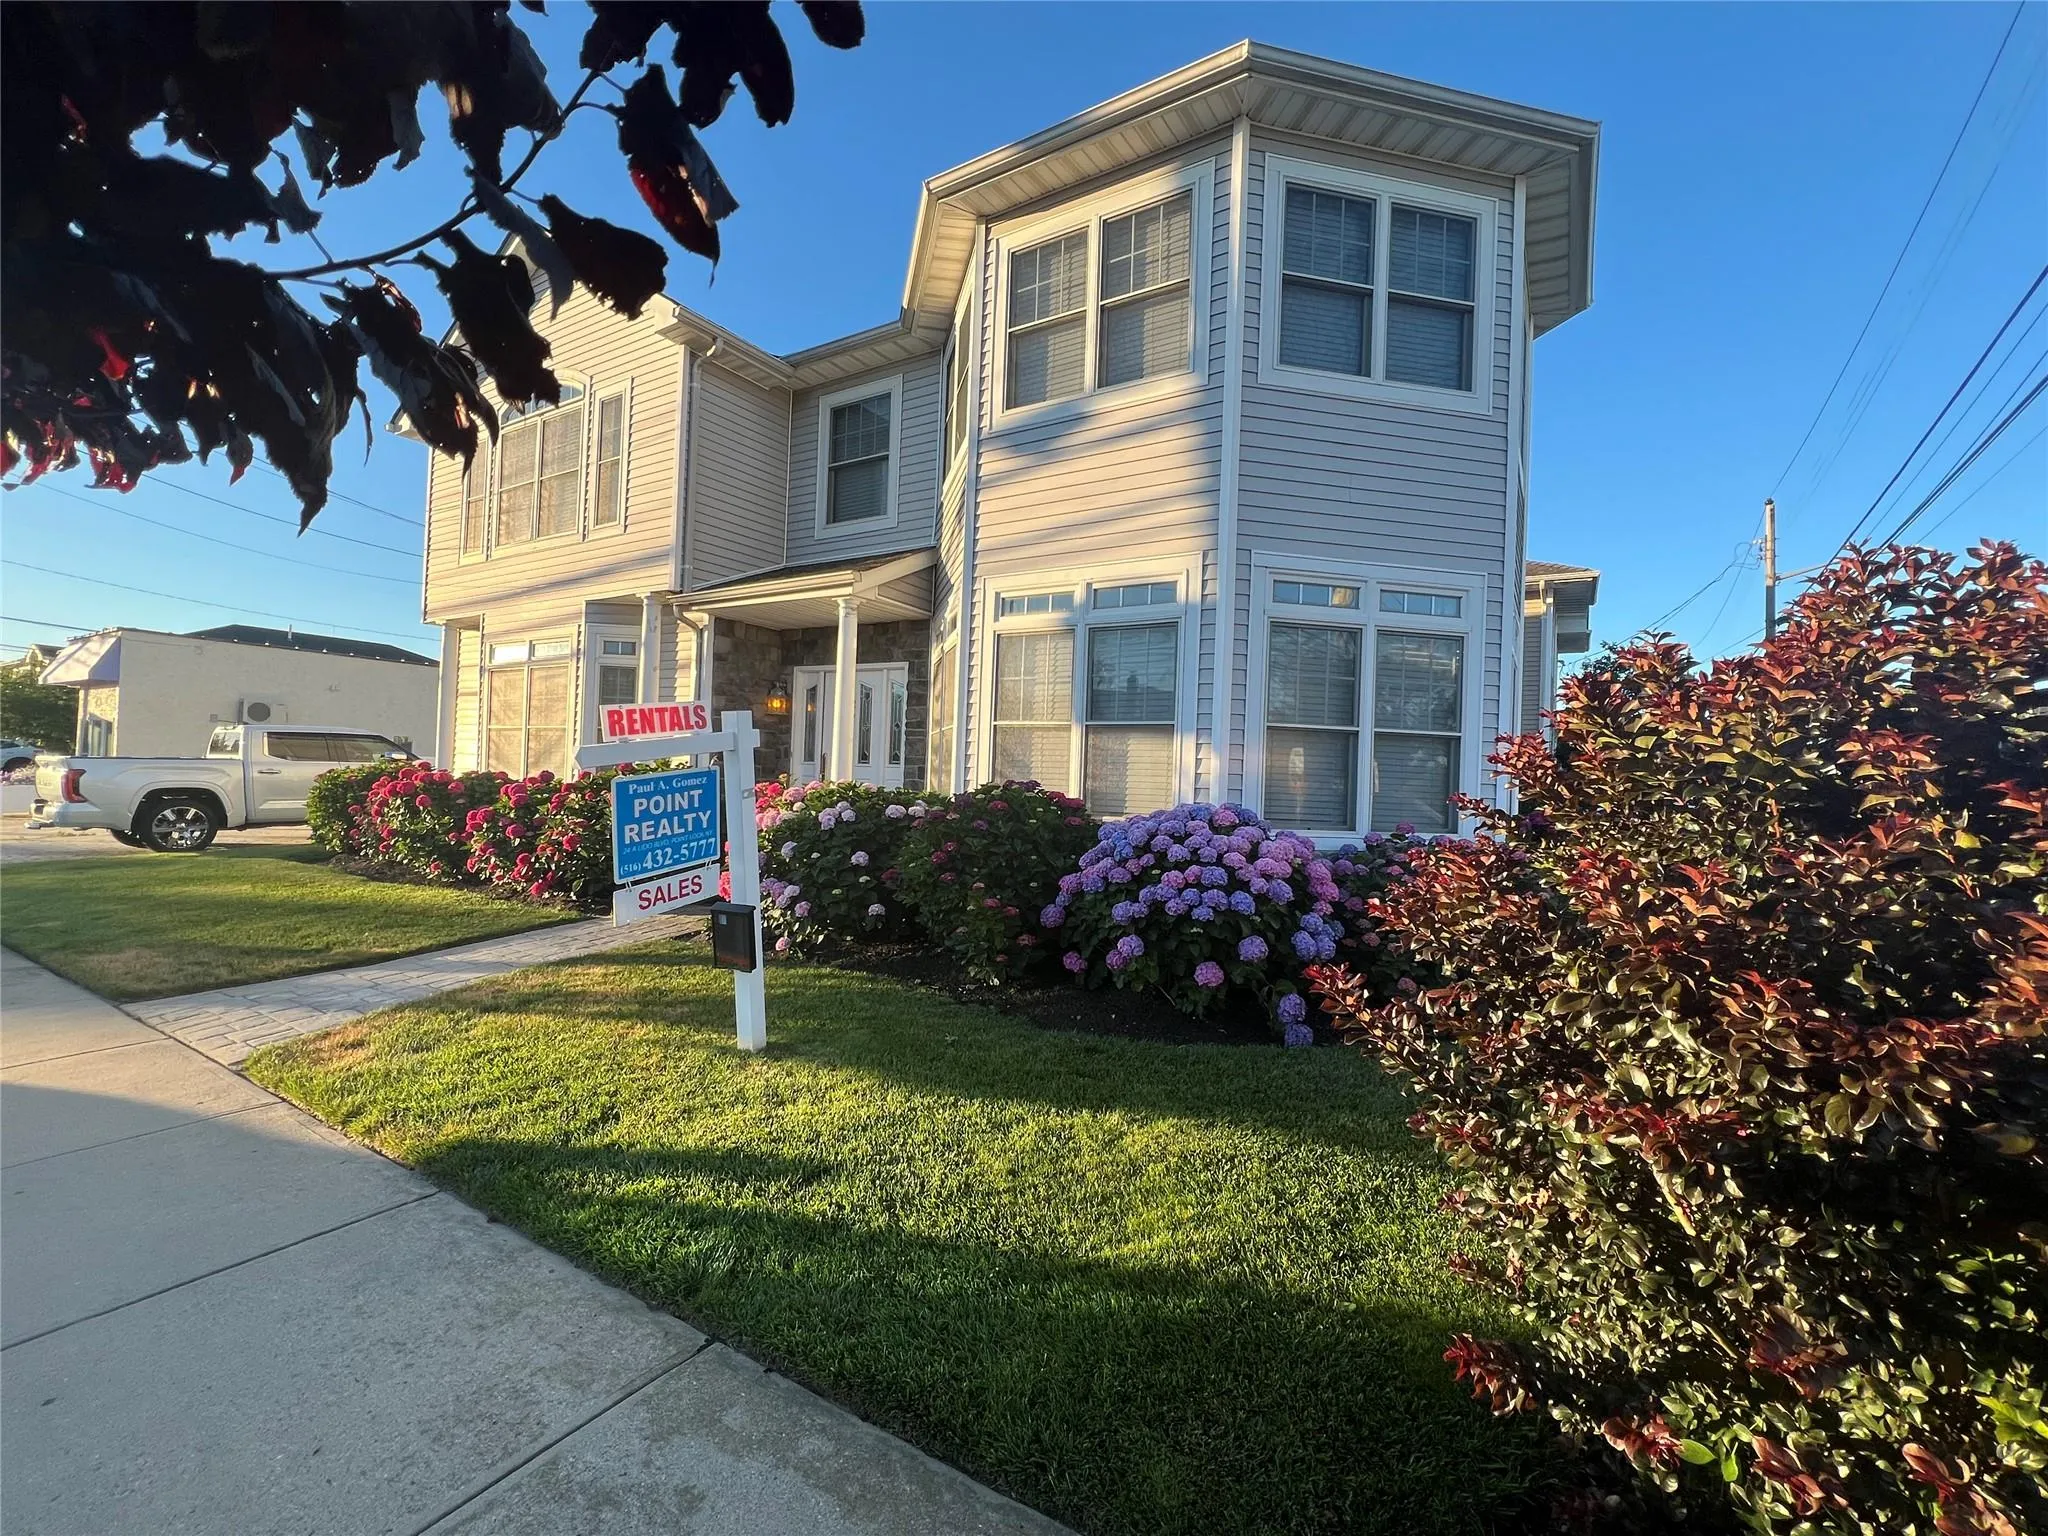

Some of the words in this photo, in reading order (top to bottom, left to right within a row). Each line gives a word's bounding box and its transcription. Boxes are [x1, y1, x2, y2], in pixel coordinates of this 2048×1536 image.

[607, 704, 708, 737] RENTALS
[628, 781, 654, 794] Paul
[657, 780, 669, 790] A.
[672, 776, 708, 788] Gomez
[633, 789, 703, 818] POINT
[624, 810, 712, 845] REALTY
[620, 862, 642, 876] (516)
[642, 837, 716, 870] 432-5777
[638, 874, 703, 911] SALES
